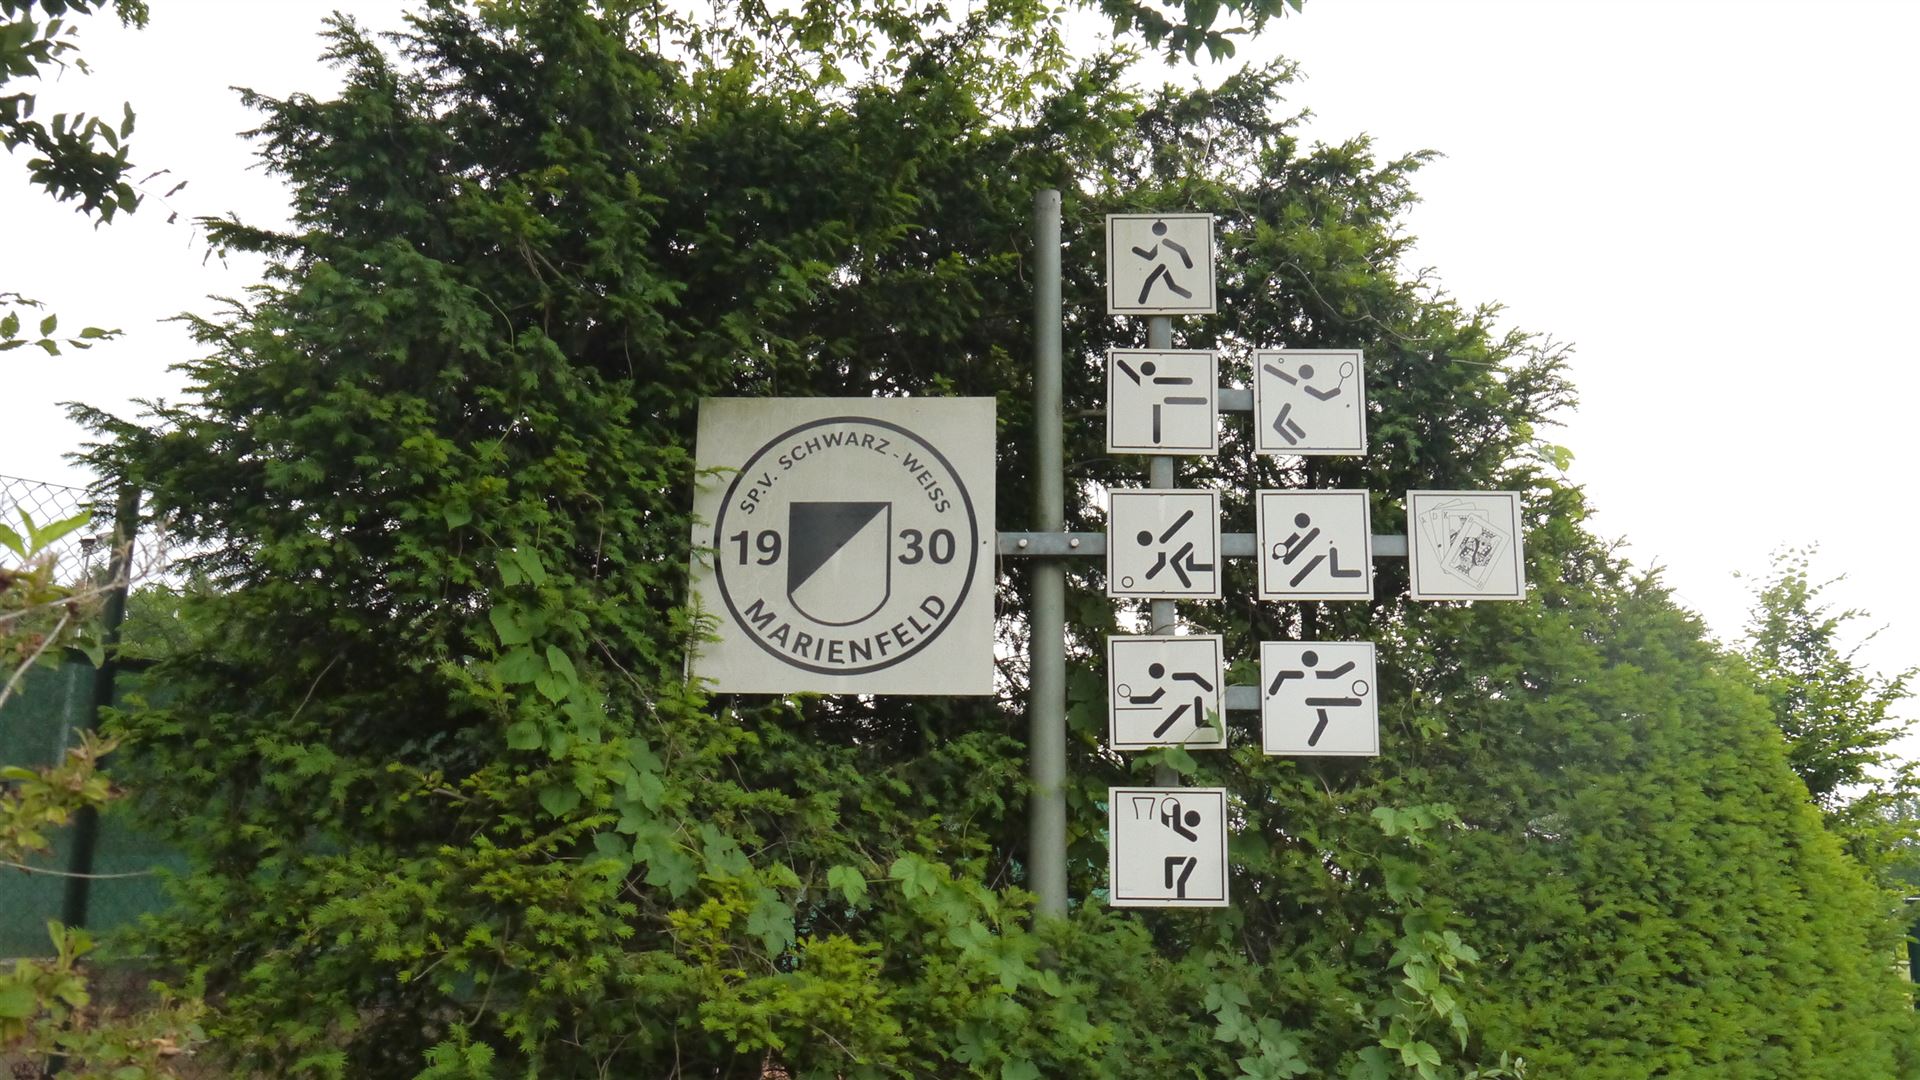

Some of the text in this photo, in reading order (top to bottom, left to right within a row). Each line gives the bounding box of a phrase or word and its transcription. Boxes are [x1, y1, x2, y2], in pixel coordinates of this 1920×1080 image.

[739, 471, 779, 515] SP.V.
[1443, 511, 1449, 519] K
[730, 529, 782, 567] 19
[897, 528, 956, 566] 30
[743, 595, 946, 665] MARIENFELD
